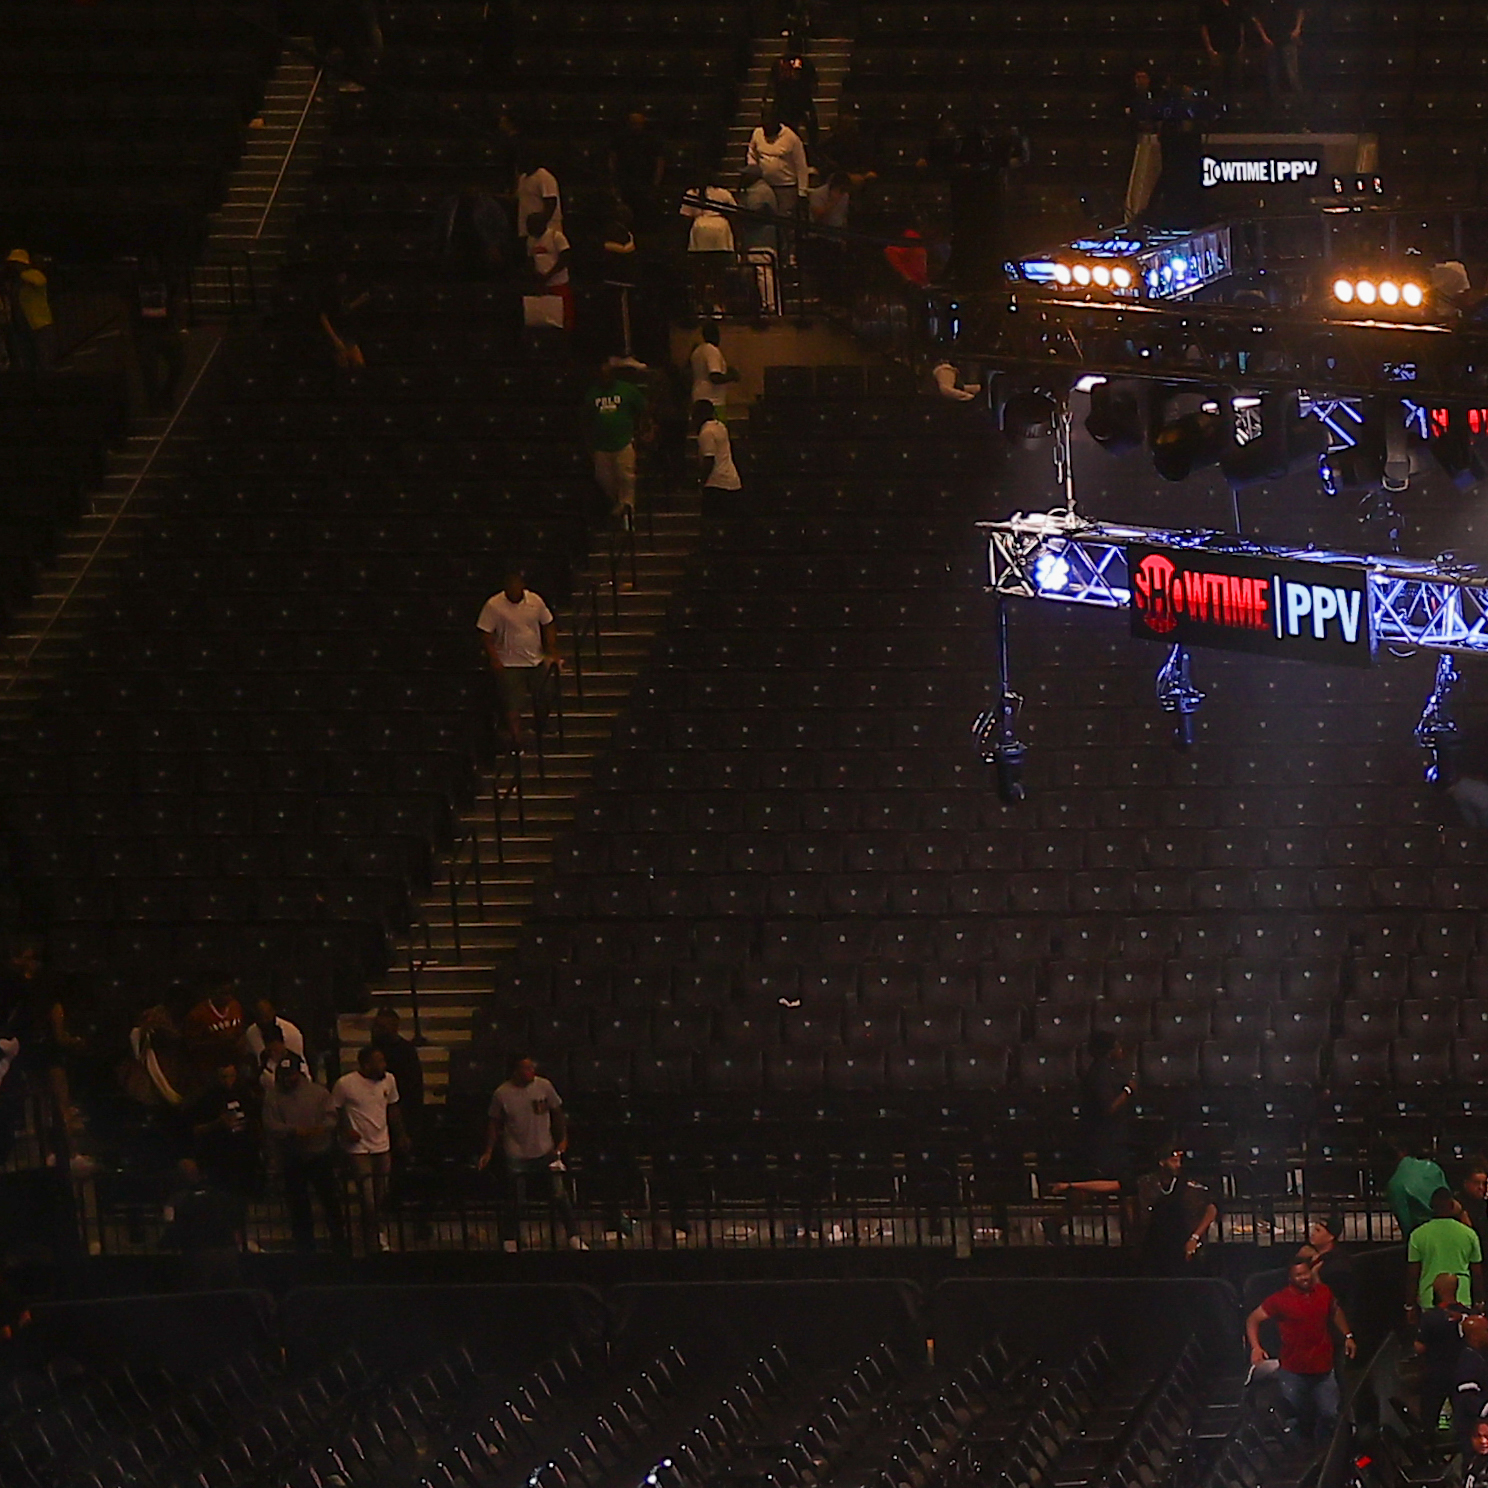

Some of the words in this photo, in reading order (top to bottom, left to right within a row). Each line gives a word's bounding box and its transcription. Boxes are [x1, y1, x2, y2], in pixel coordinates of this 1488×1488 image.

[1277, 161, 1318, 182] PPV
[1134, 553, 1271, 634] SHOWTIME
[1285, 581, 1363, 644] PPV
